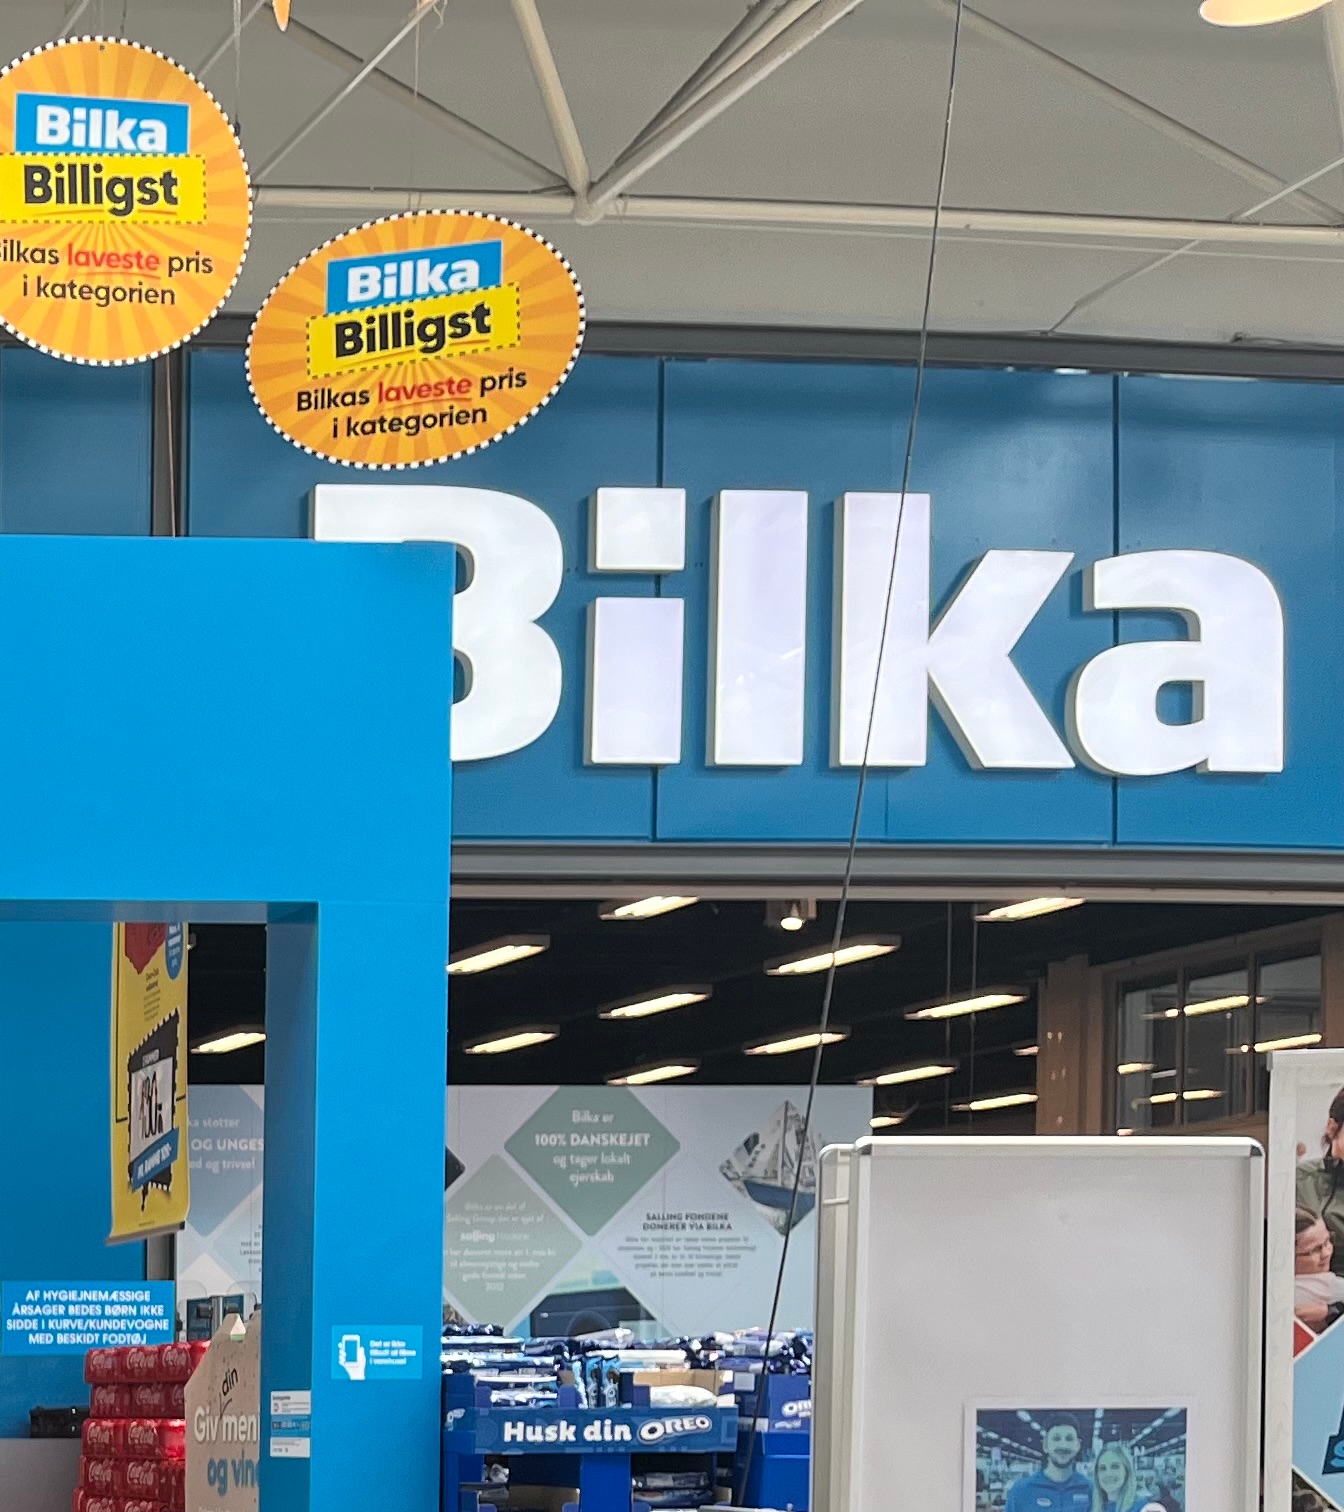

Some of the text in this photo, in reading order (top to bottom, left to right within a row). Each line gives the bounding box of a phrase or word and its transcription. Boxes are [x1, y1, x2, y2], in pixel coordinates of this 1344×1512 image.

[36, 105, 167, 152] Bilka
[24, 163, 178, 216] Billigst
[68, 244, 160, 270] laveste
[168, 251, 213, 277] pris
[23, 274, 175, 307] i kategorien
[348, 259, 480, 302] Bilka
[335, 301, 491, 358] Billigst
[297, 367, 527, 411] Bilkas laveste pris
[333, 406, 487, 438] i kategorien
[311, 482, 1286, 777] Bilka
[572, 1109, 600, 1124] Bilka
[191, 1139, 212, 1151] OG
[534, 1133, 651, 1147] 100% DANSKEJET
[12, 1302, 164, 1316] ÅRSAGER BEDES BØRN IKKE
[26, 1290, 150, 1302] AF HYGIEJNEMÆSSIGE
[6, 1319, 38, 1330] SIDDE
[48, 1319, 169, 1330] KURVE/KUNDEVOGNE
[29, 1333, 146, 1345] MED BESKIDT FODTØJ
[221, 1367, 239, 1396] din
[194, 1406, 220, 1442] Giv
[503, 1416, 710, 1443] Husk din OREO
[207, 1458, 227, 1497] og
